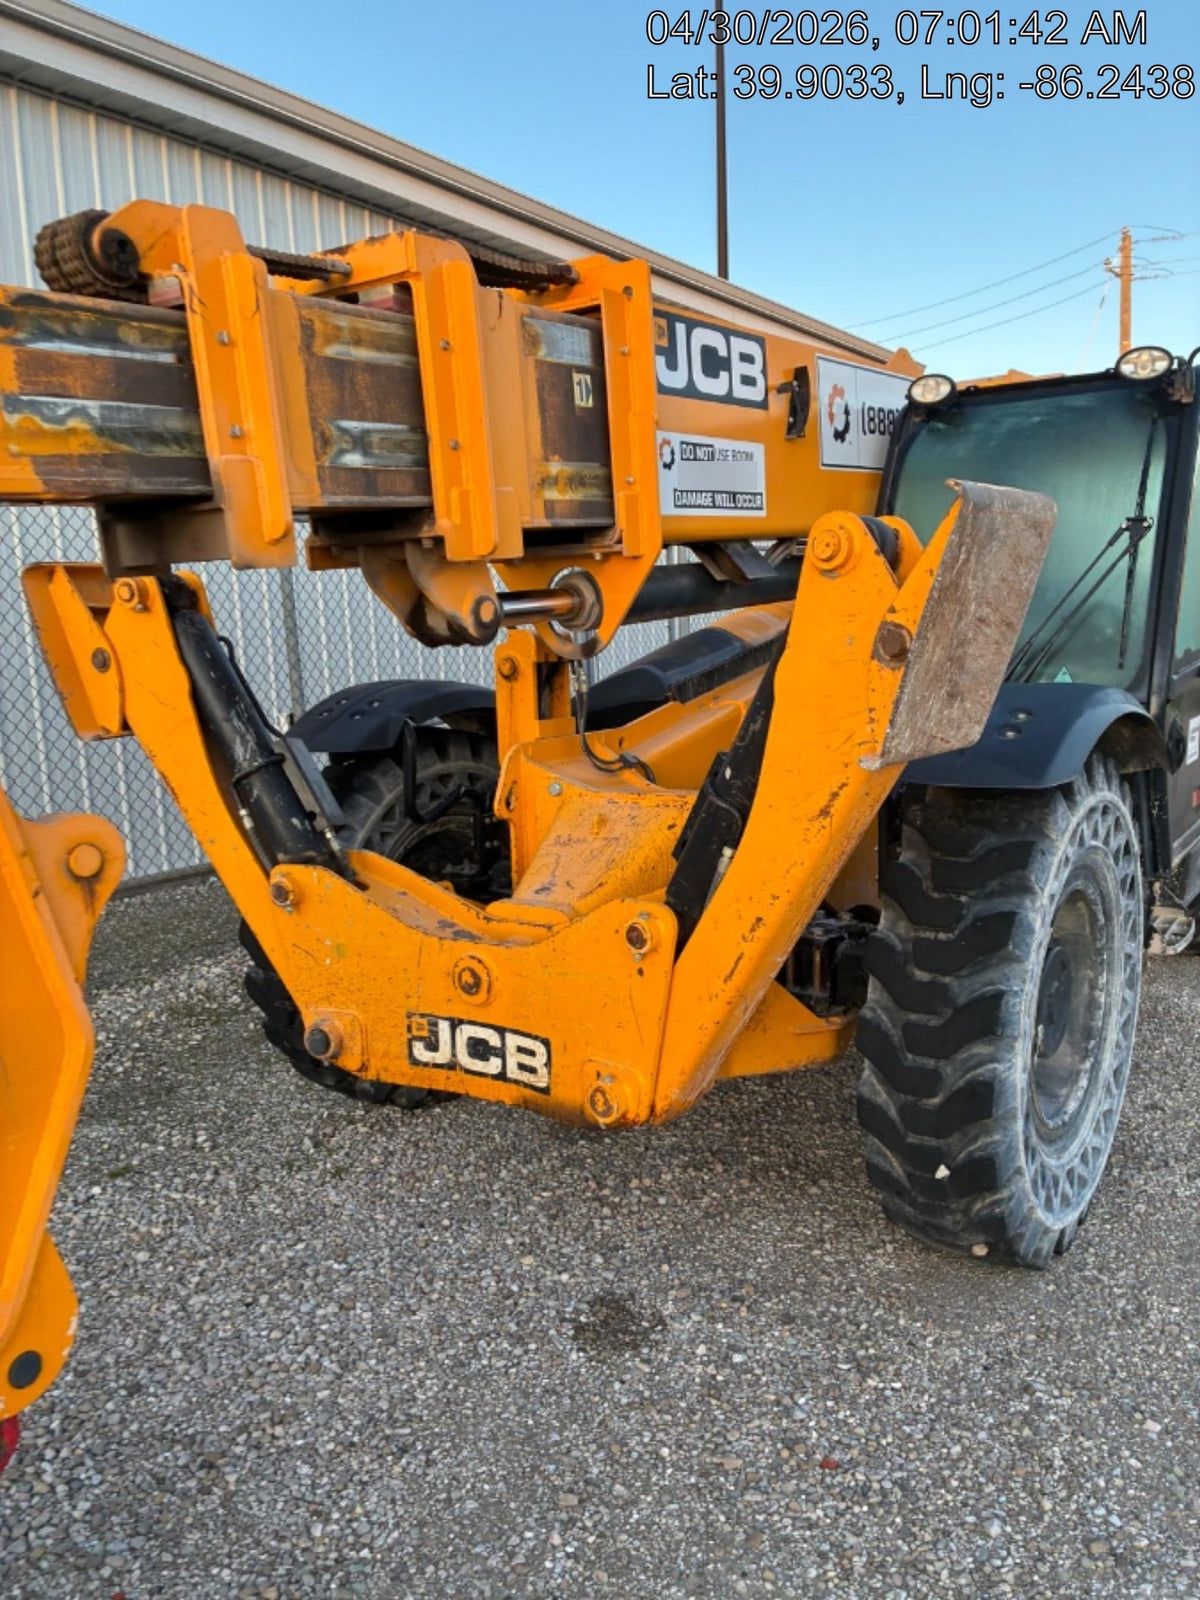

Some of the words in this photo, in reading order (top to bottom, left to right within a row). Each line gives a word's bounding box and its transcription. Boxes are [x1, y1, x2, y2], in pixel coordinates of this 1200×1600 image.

[655, 320, 765, 402] JCB
[861, 401, 900, 436] (888
[681, 443, 695, 461] DO
[695, 445, 714, 461] NOT
[675, 490, 714, 507] DAMAGE
[714, 492, 735, 508] WILL
[735, 493, 763, 509] OCCUR
[411, 1016, 549, 1088] JCB
